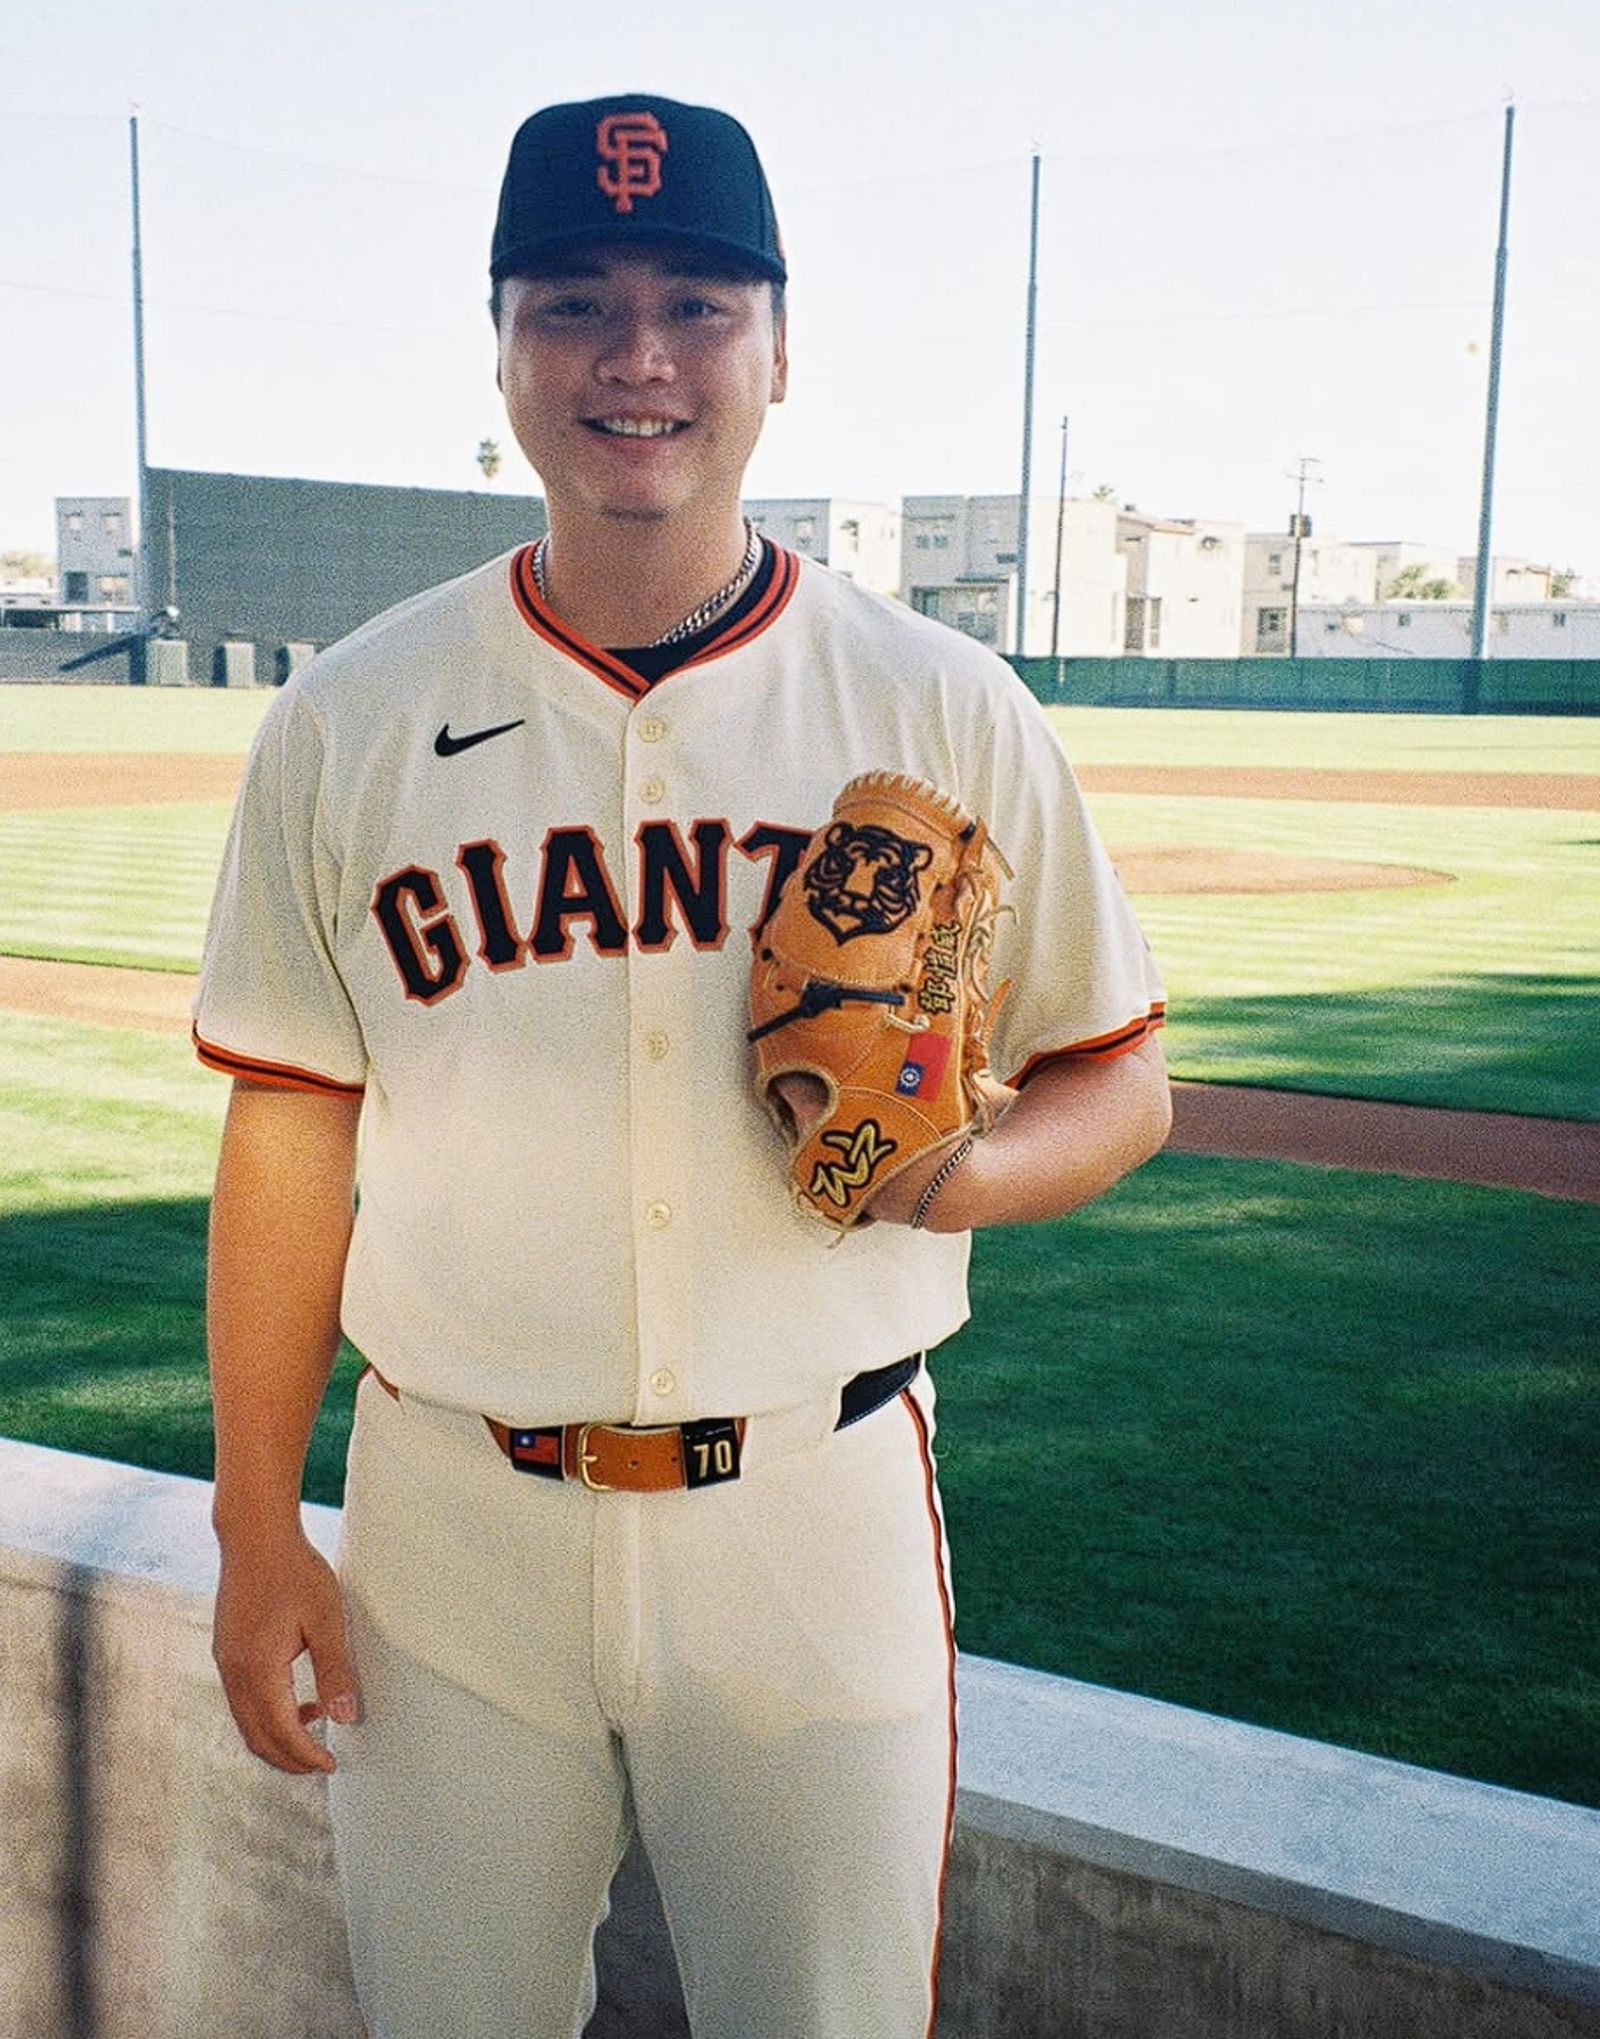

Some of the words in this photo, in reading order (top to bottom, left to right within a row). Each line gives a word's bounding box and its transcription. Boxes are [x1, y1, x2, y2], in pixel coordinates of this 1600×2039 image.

[596, 111, 668, 214] SF
[371, 818, 817, 1007] GIANT
[693, 1439, 732, 1478] 70
